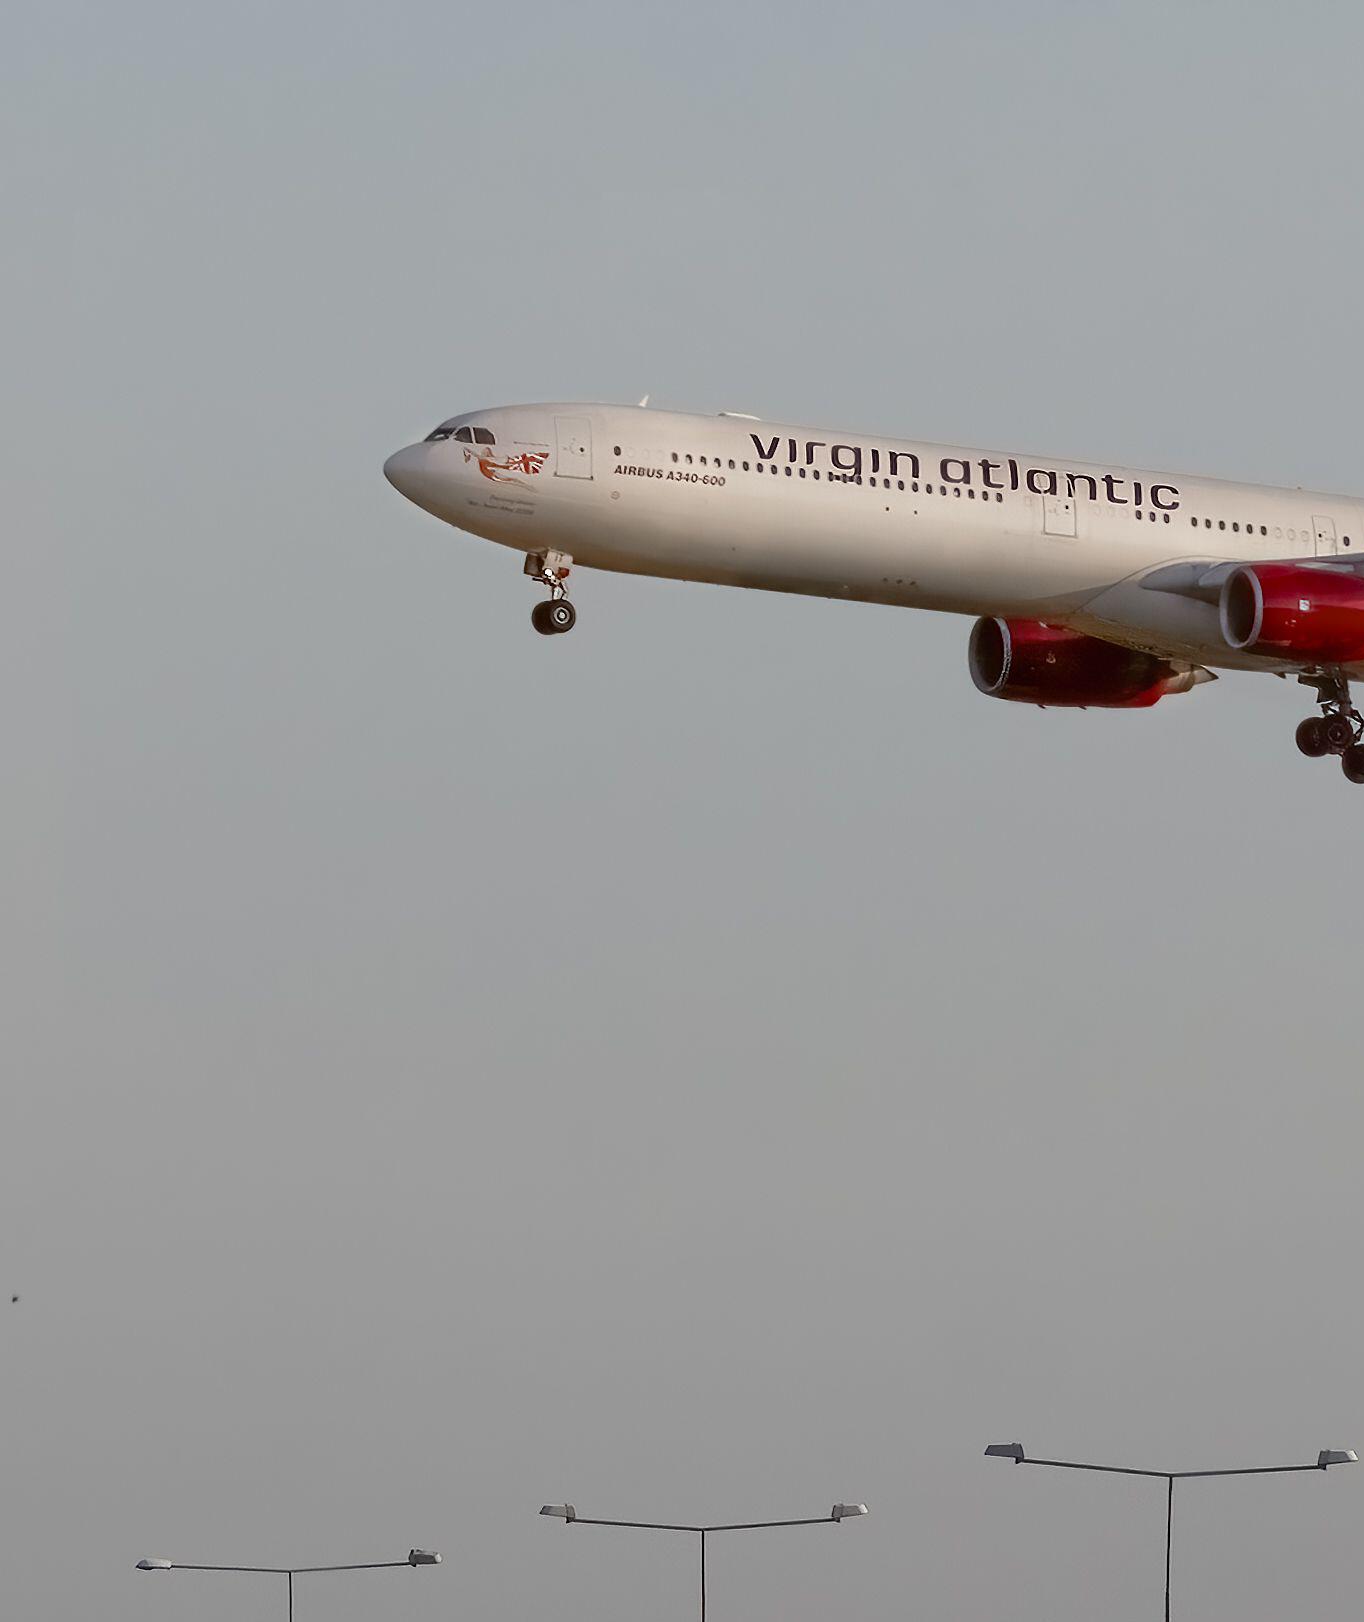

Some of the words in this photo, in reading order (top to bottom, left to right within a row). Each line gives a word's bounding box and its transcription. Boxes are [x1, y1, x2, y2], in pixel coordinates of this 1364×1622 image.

[614, 465, 663, 479] AIRBUS
[666, 471, 726, 487] A340-600
[750, 434, 919, 484] virgin
[940, 458, 1179, 510] atlantic
